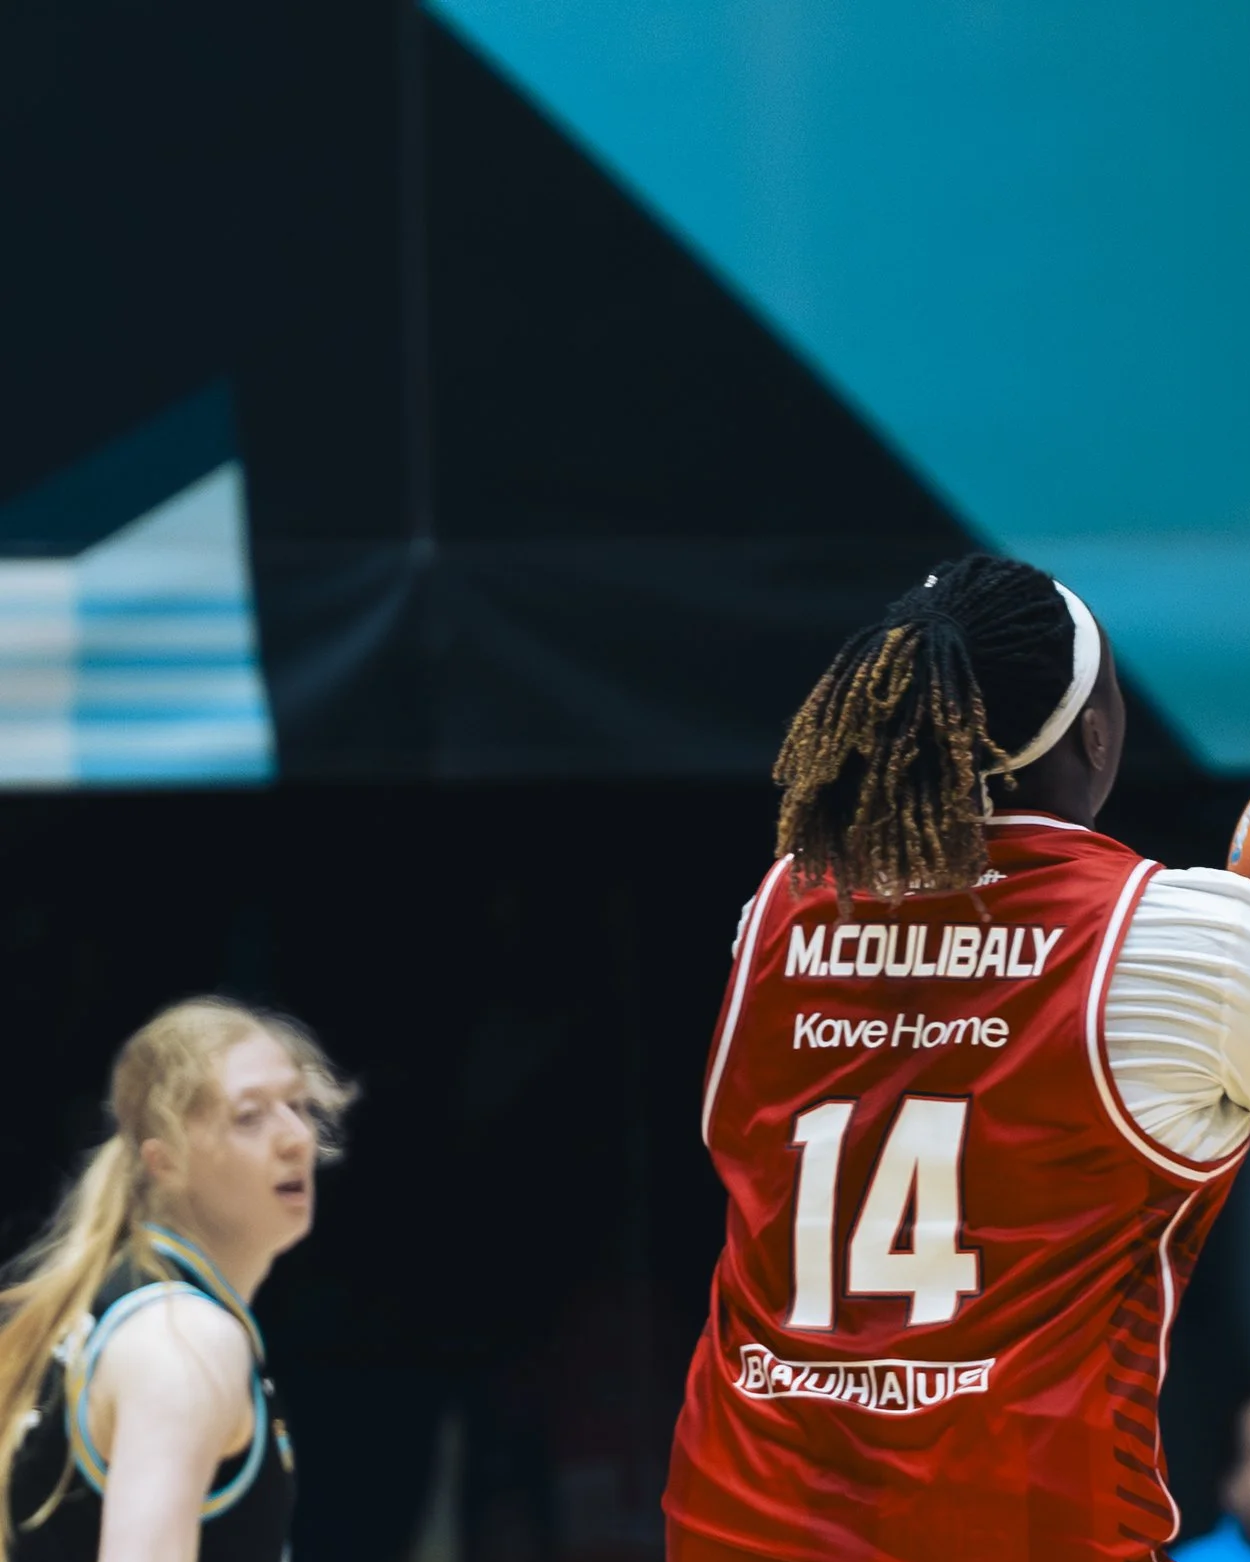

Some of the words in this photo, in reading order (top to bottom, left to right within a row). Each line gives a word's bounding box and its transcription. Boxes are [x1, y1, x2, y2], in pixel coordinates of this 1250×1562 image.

[784, 923, 1066, 979] M.COULIBALY
[792, 1011, 889, 1050] Kave
[890, 1013, 1010, 1050] Home
[786, 1098, 978, 1329] 14
[742, 1352, 988, 1408] BAUHAUS
